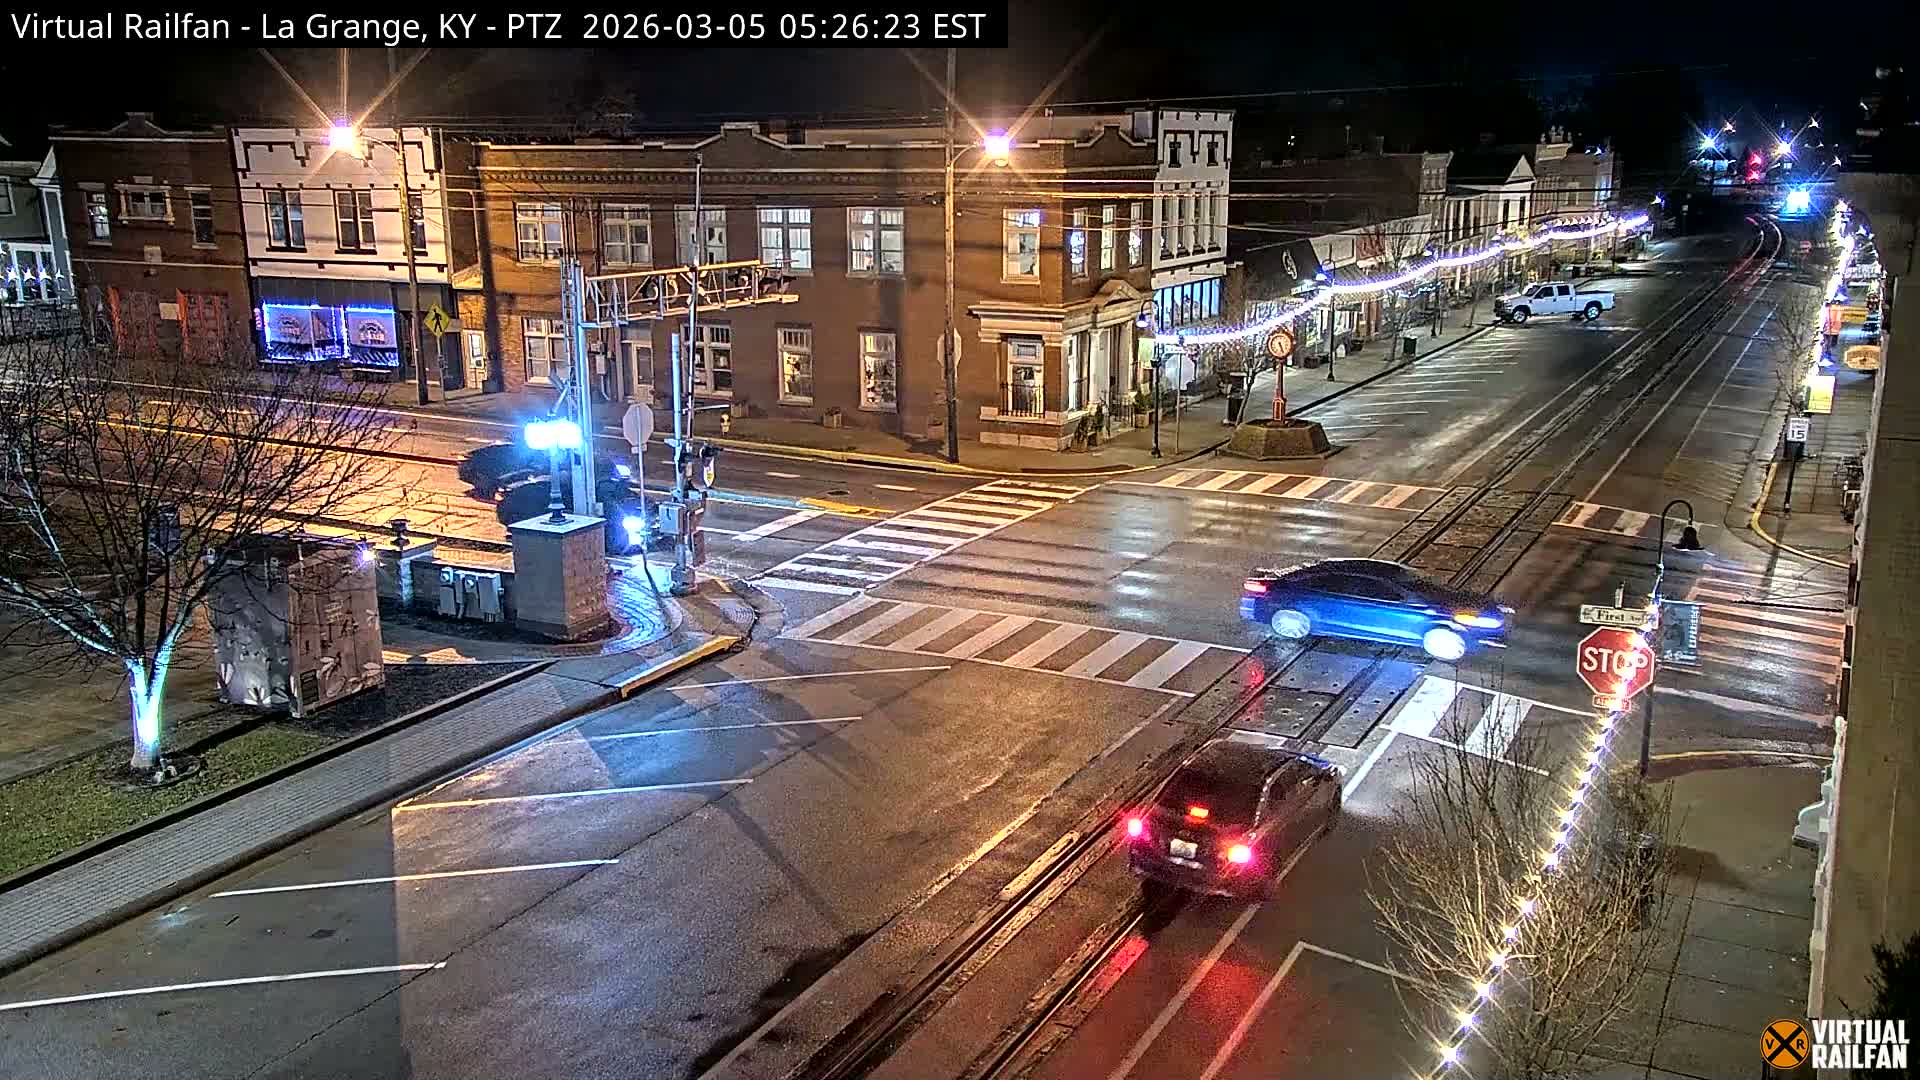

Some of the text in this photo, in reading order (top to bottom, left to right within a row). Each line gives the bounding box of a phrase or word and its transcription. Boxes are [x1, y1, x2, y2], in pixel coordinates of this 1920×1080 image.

[1791, 429, 1806, 440] 15
[1597, 609, 1625, 621] First
[1582, 646, 1649, 679] STOP
